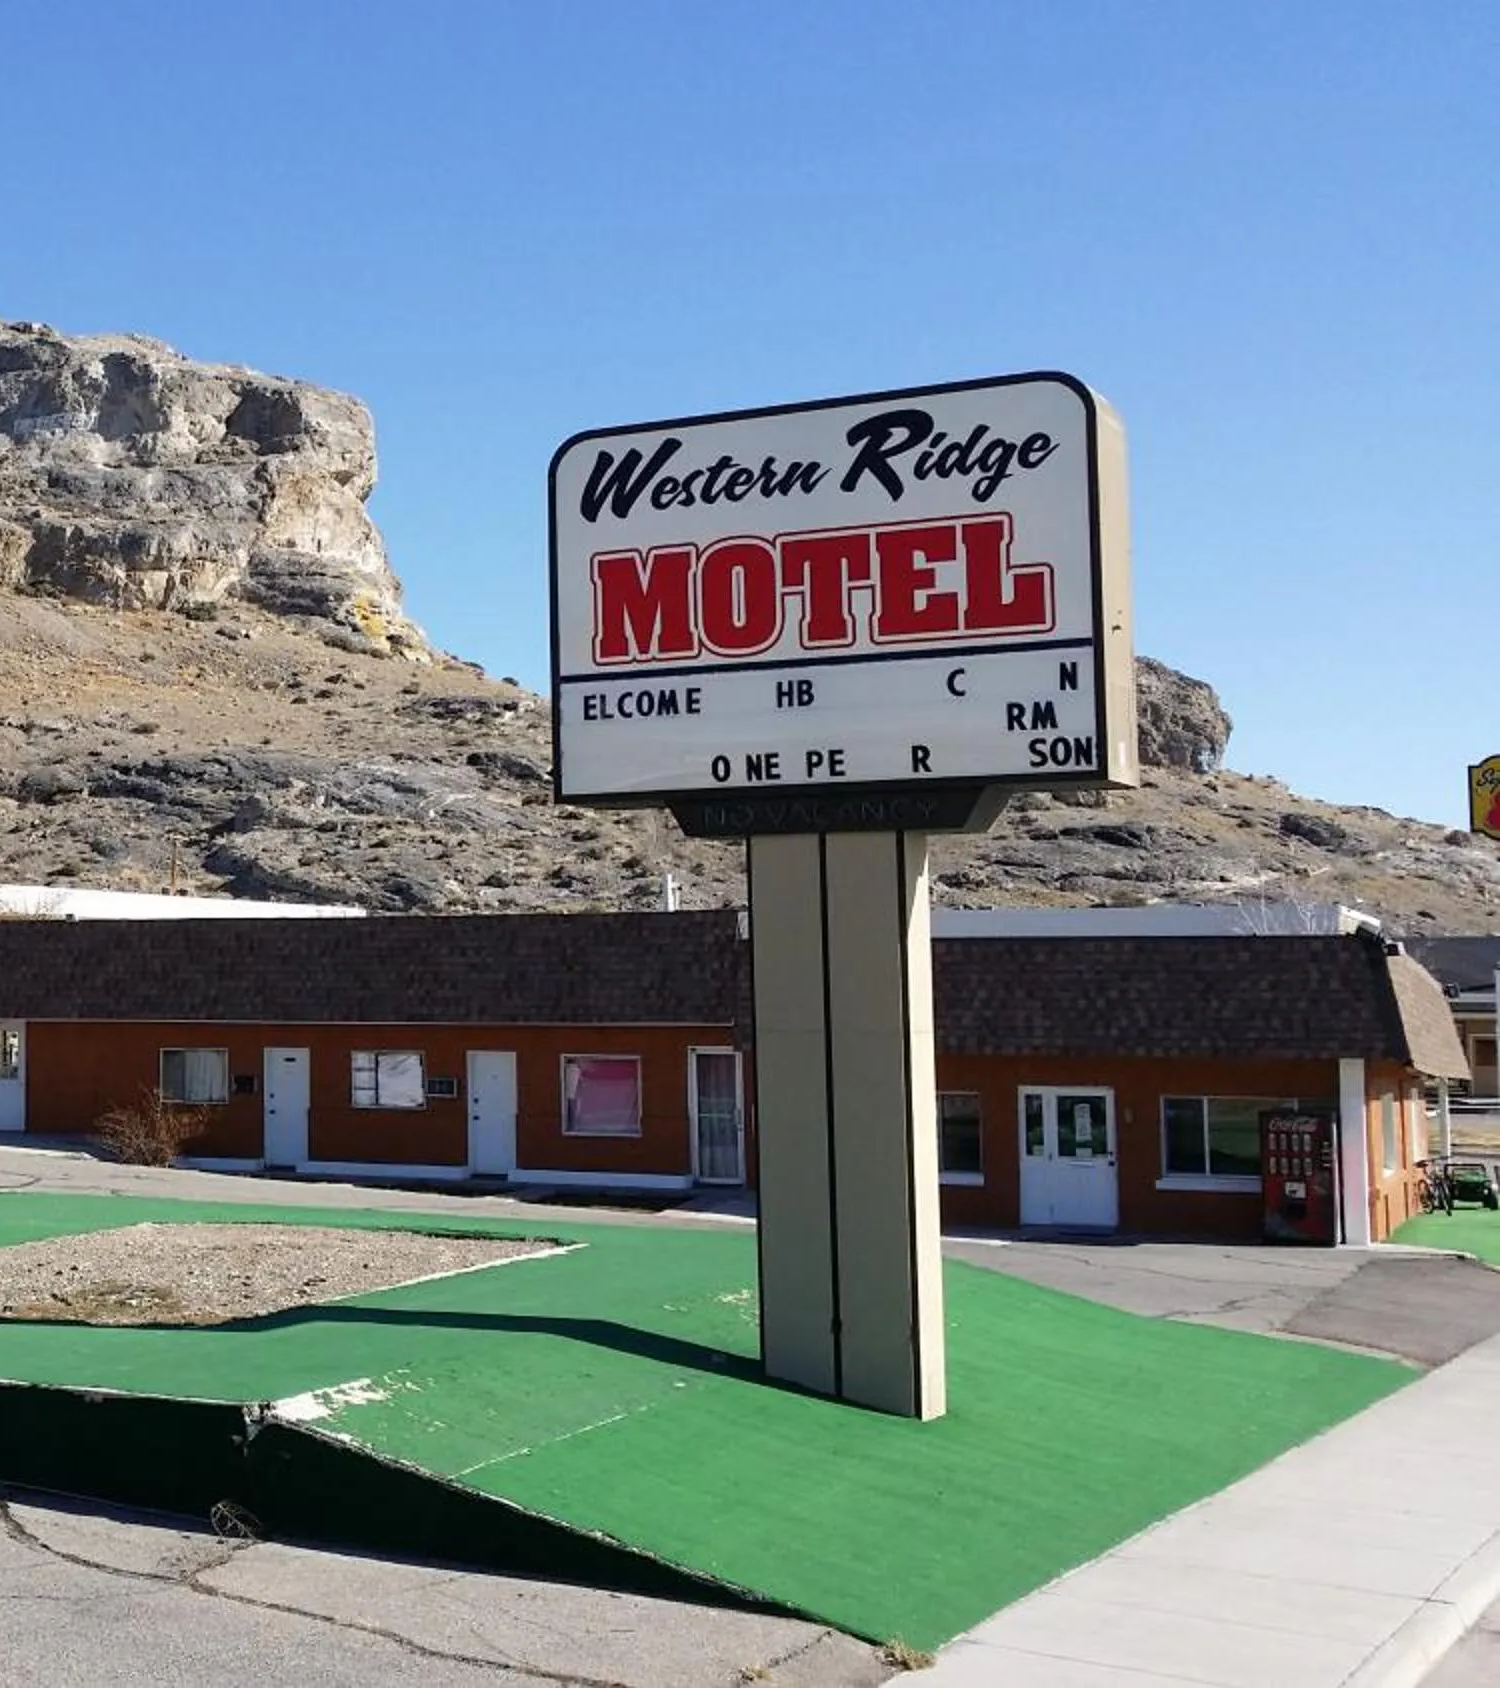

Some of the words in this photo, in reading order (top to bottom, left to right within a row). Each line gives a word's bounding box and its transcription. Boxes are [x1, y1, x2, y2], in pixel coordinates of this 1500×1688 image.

[580, 437, 832, 523] Western
[840, 409, 1061, 502] Ridge
[591, 512, 1055, 665] MOTEL
[583, 687, 701, 721] ELCOME
[776, 679, 815, 708] HB
[1006, 700, 1058, 731] RM
[1028, 736, 1093, 768] SON
